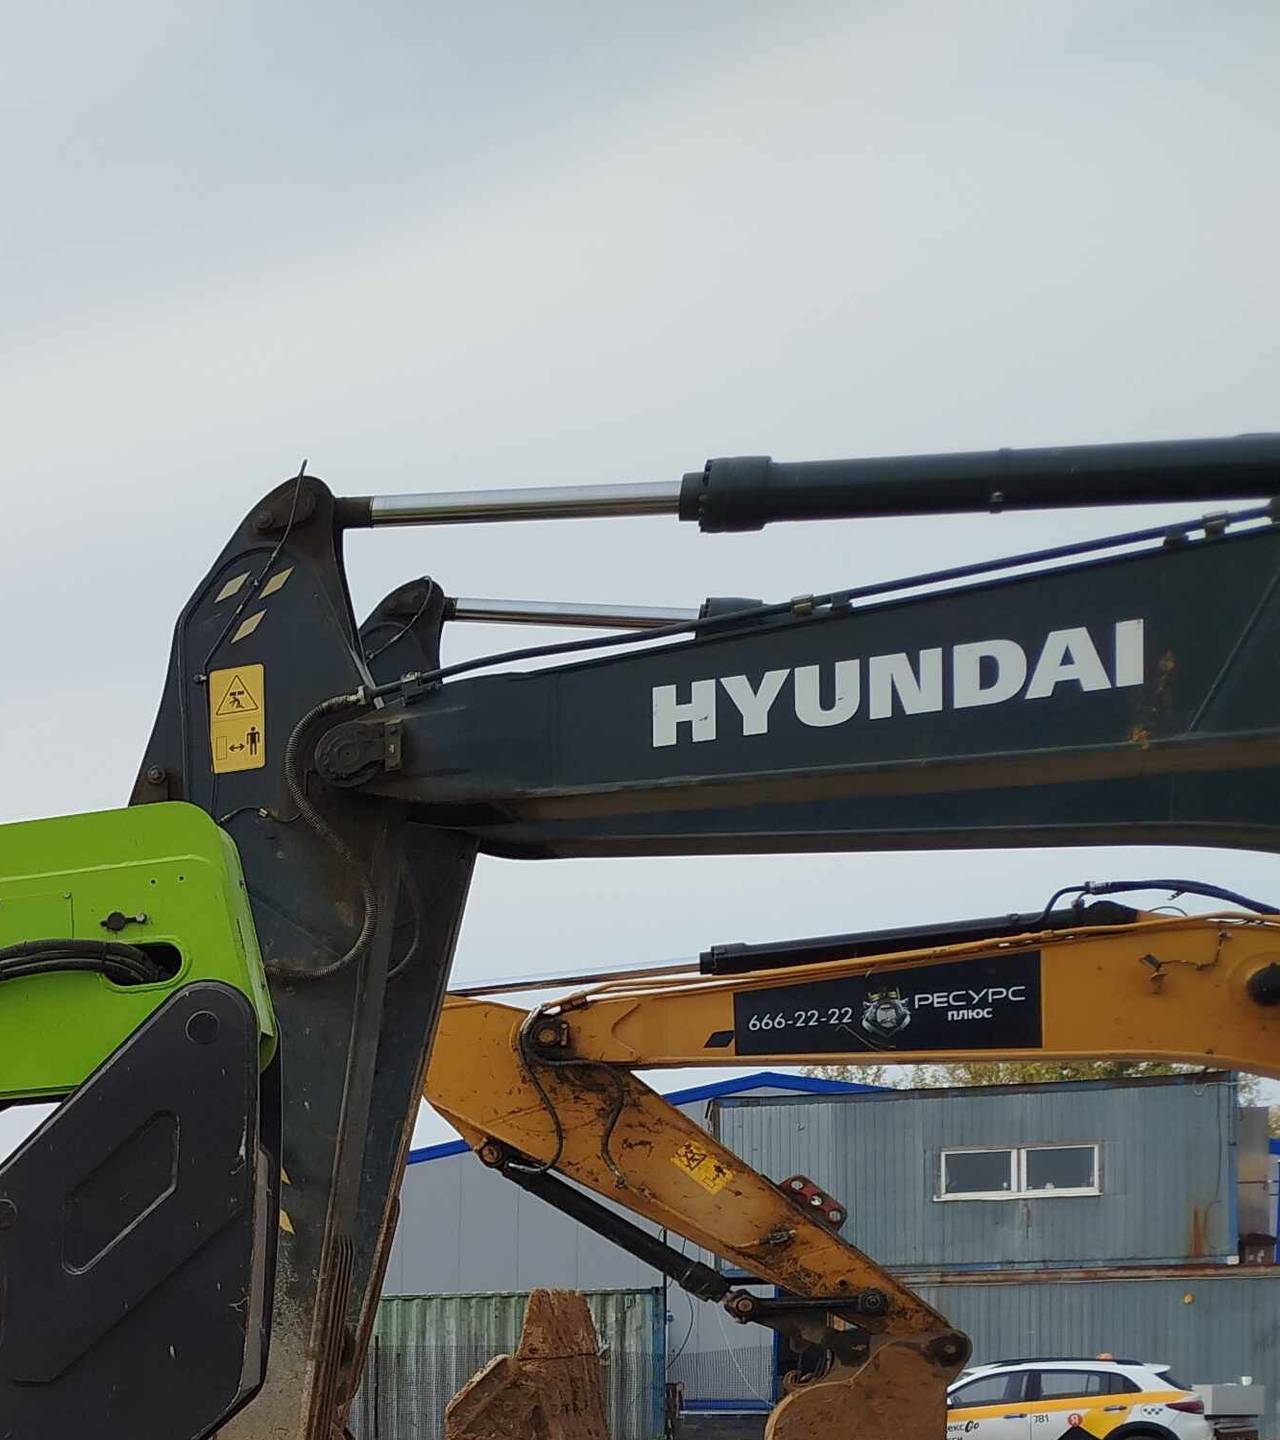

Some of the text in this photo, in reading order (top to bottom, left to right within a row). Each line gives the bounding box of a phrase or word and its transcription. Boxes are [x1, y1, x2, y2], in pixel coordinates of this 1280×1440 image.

[652, 618, 1144, 748] HYUNDAI
[914, 985, 1026, 1009] РЕСУРС
[748, 1006, 853, 1031] 666-22-22
